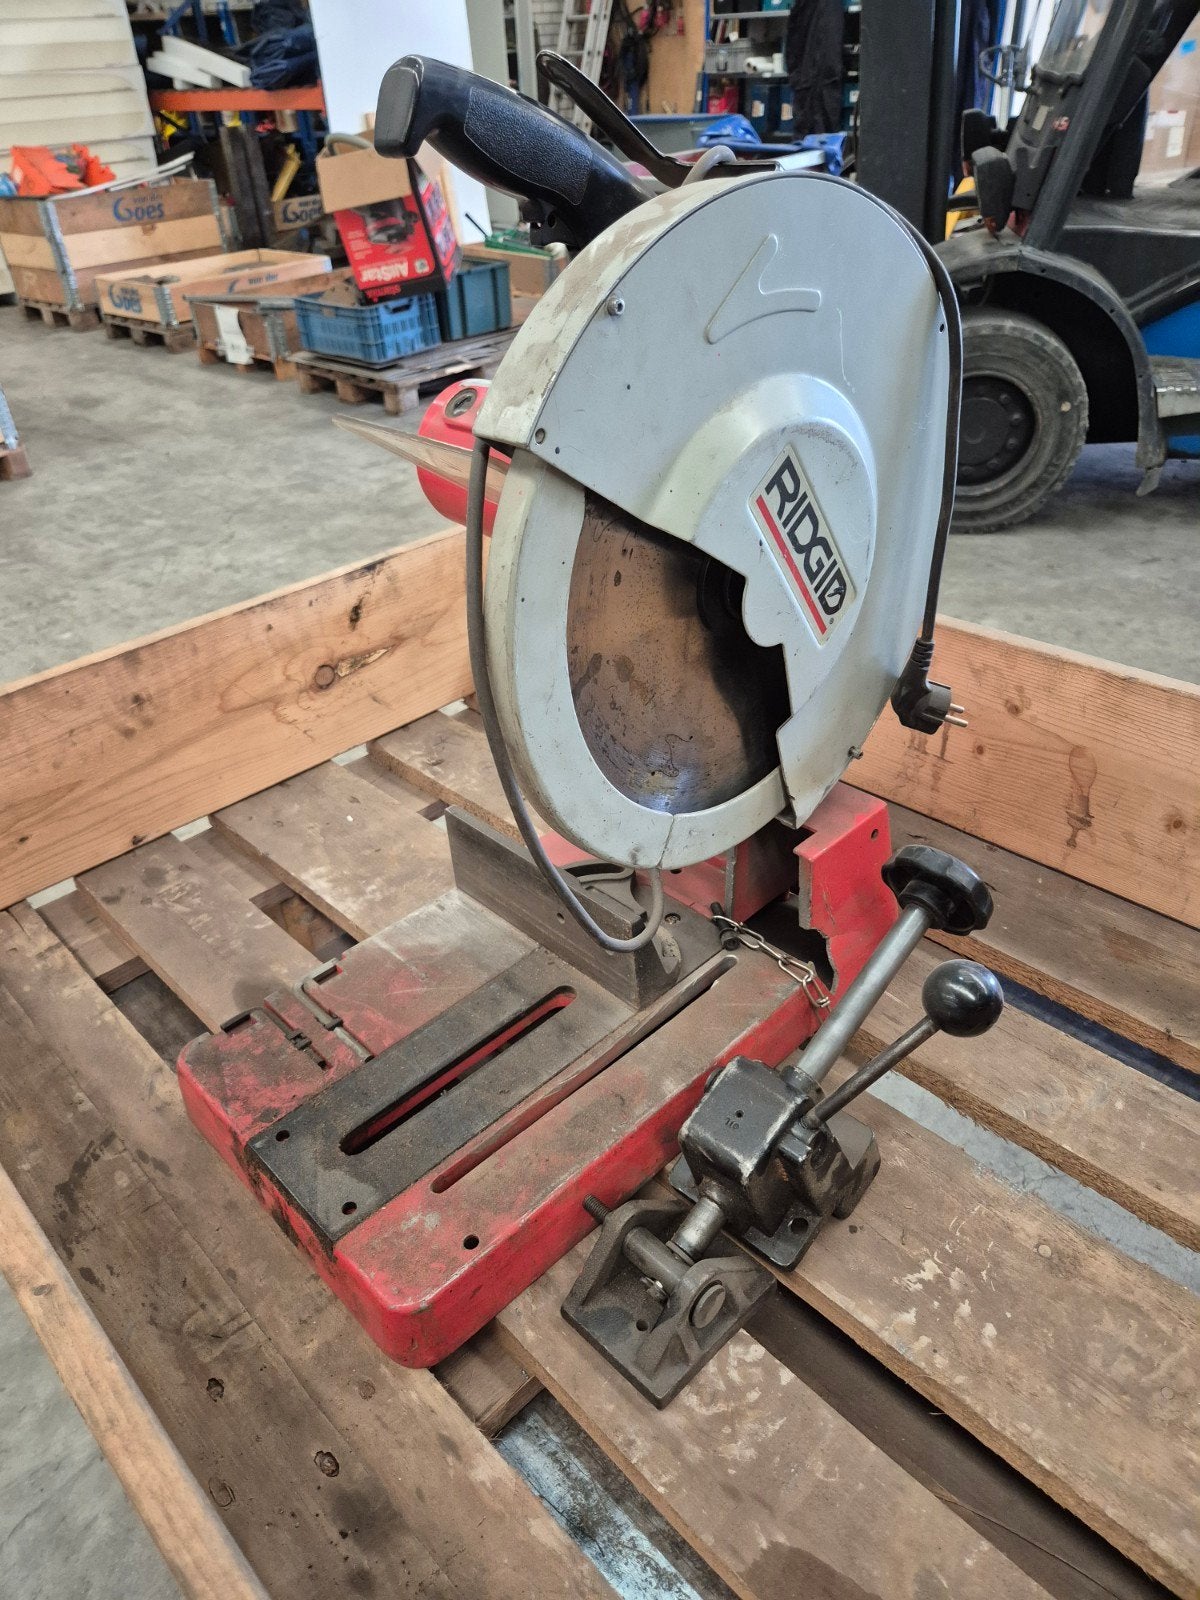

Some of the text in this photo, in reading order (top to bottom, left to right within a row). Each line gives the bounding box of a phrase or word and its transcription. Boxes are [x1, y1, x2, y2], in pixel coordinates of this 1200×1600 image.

[113, 197, 165, 222] Goes
[361, 262, 409, 283] AllStar
[108, 283, 143, 314] Goes
[764, 455, 847, 616] RIDGID
